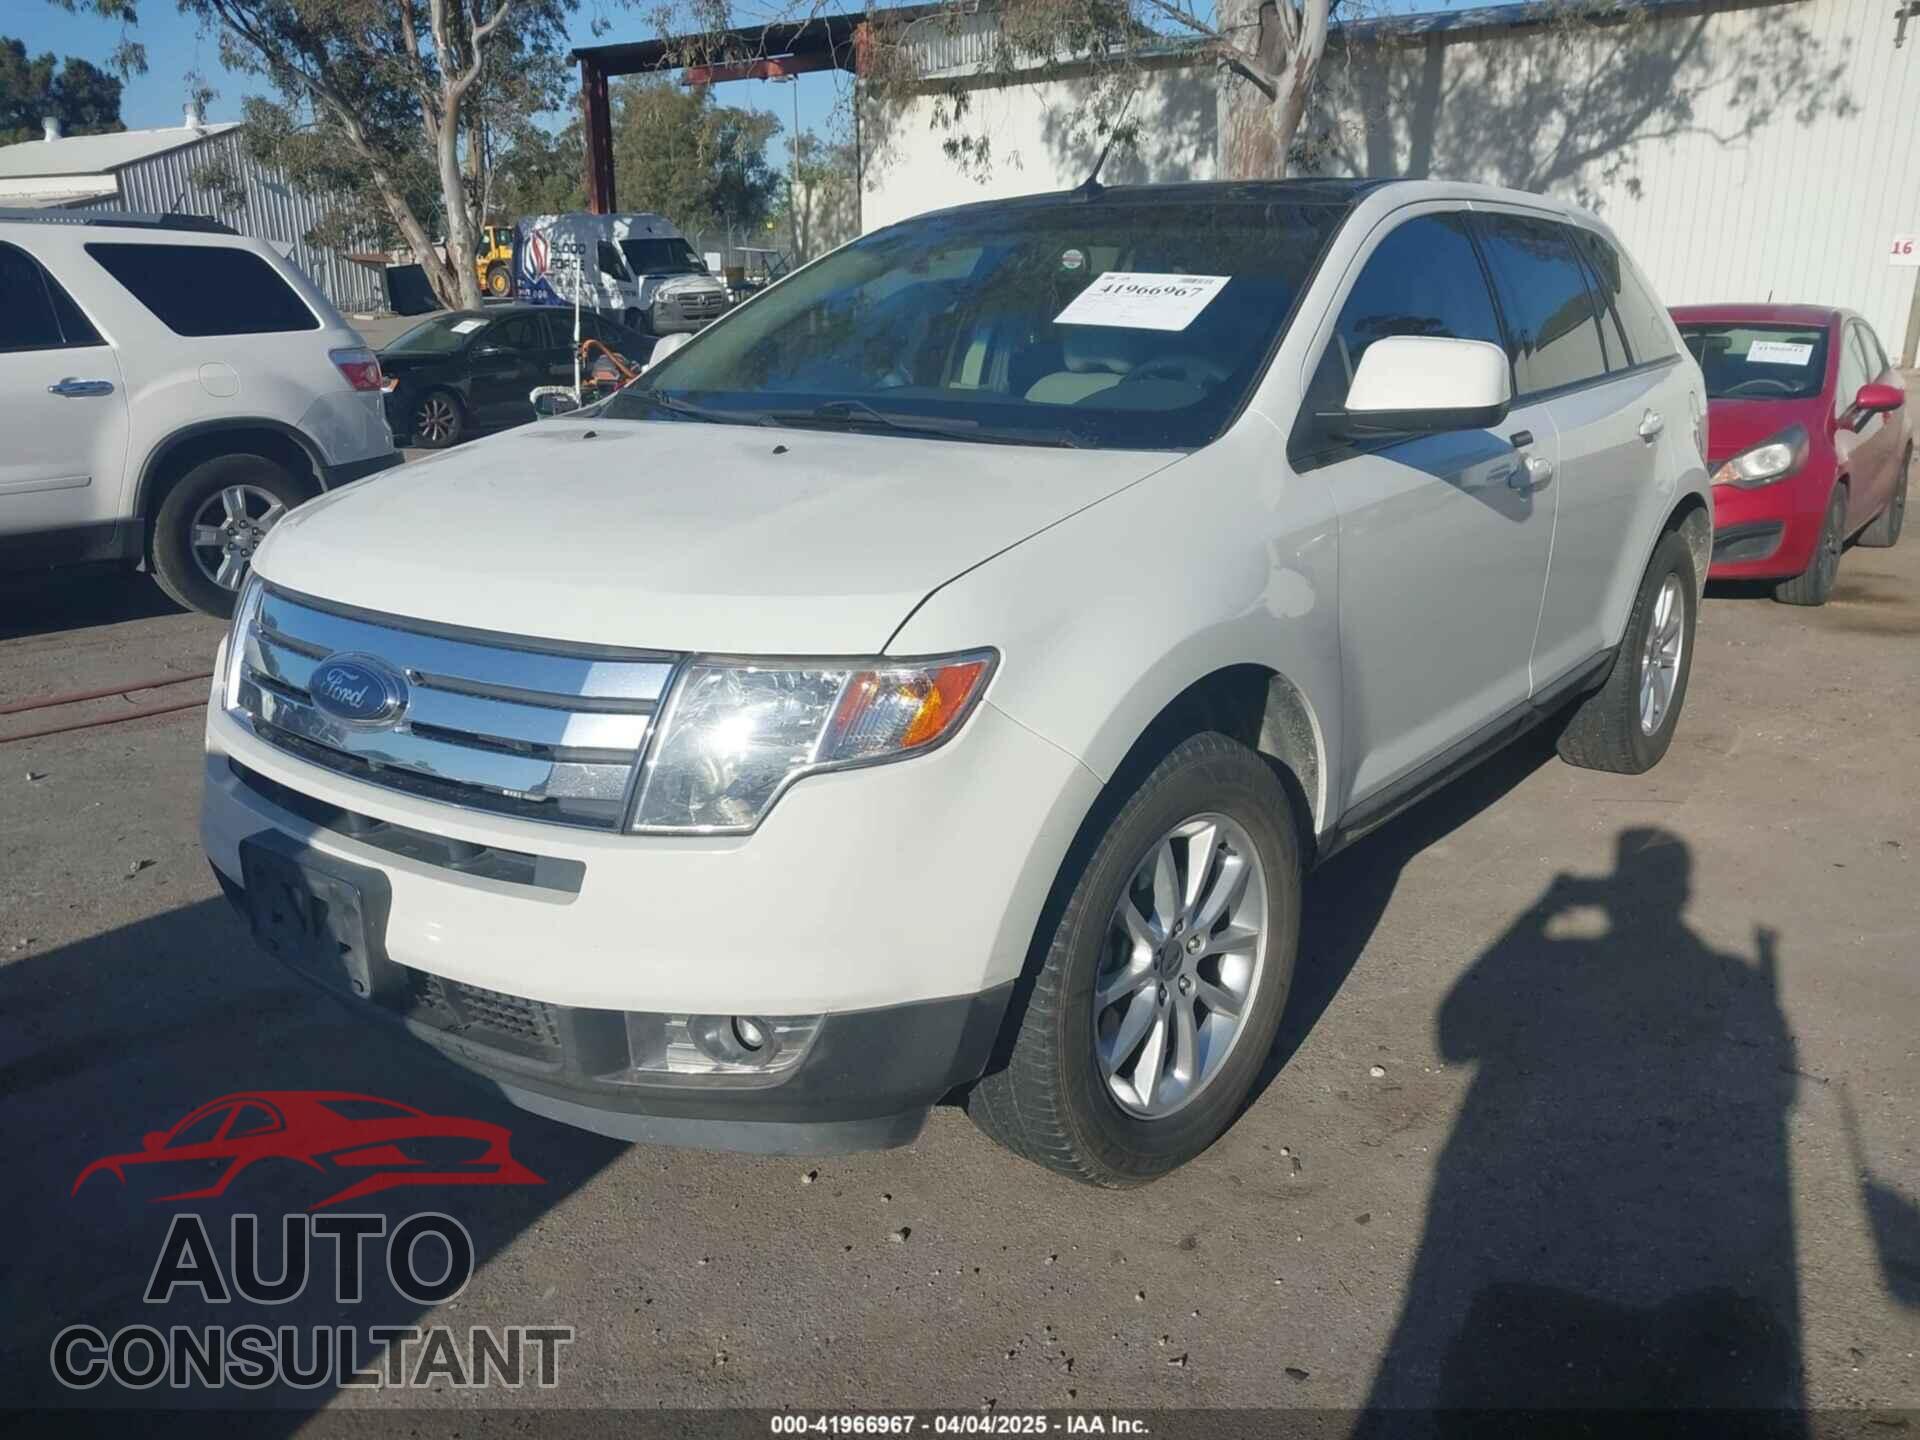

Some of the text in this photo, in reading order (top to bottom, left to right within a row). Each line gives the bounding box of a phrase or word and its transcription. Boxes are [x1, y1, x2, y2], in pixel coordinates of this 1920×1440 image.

[1891, 241, 1912, 255] 16
[1099, 283, 1203, 298] 41966967
[326, 668, 369, 708] Ford
